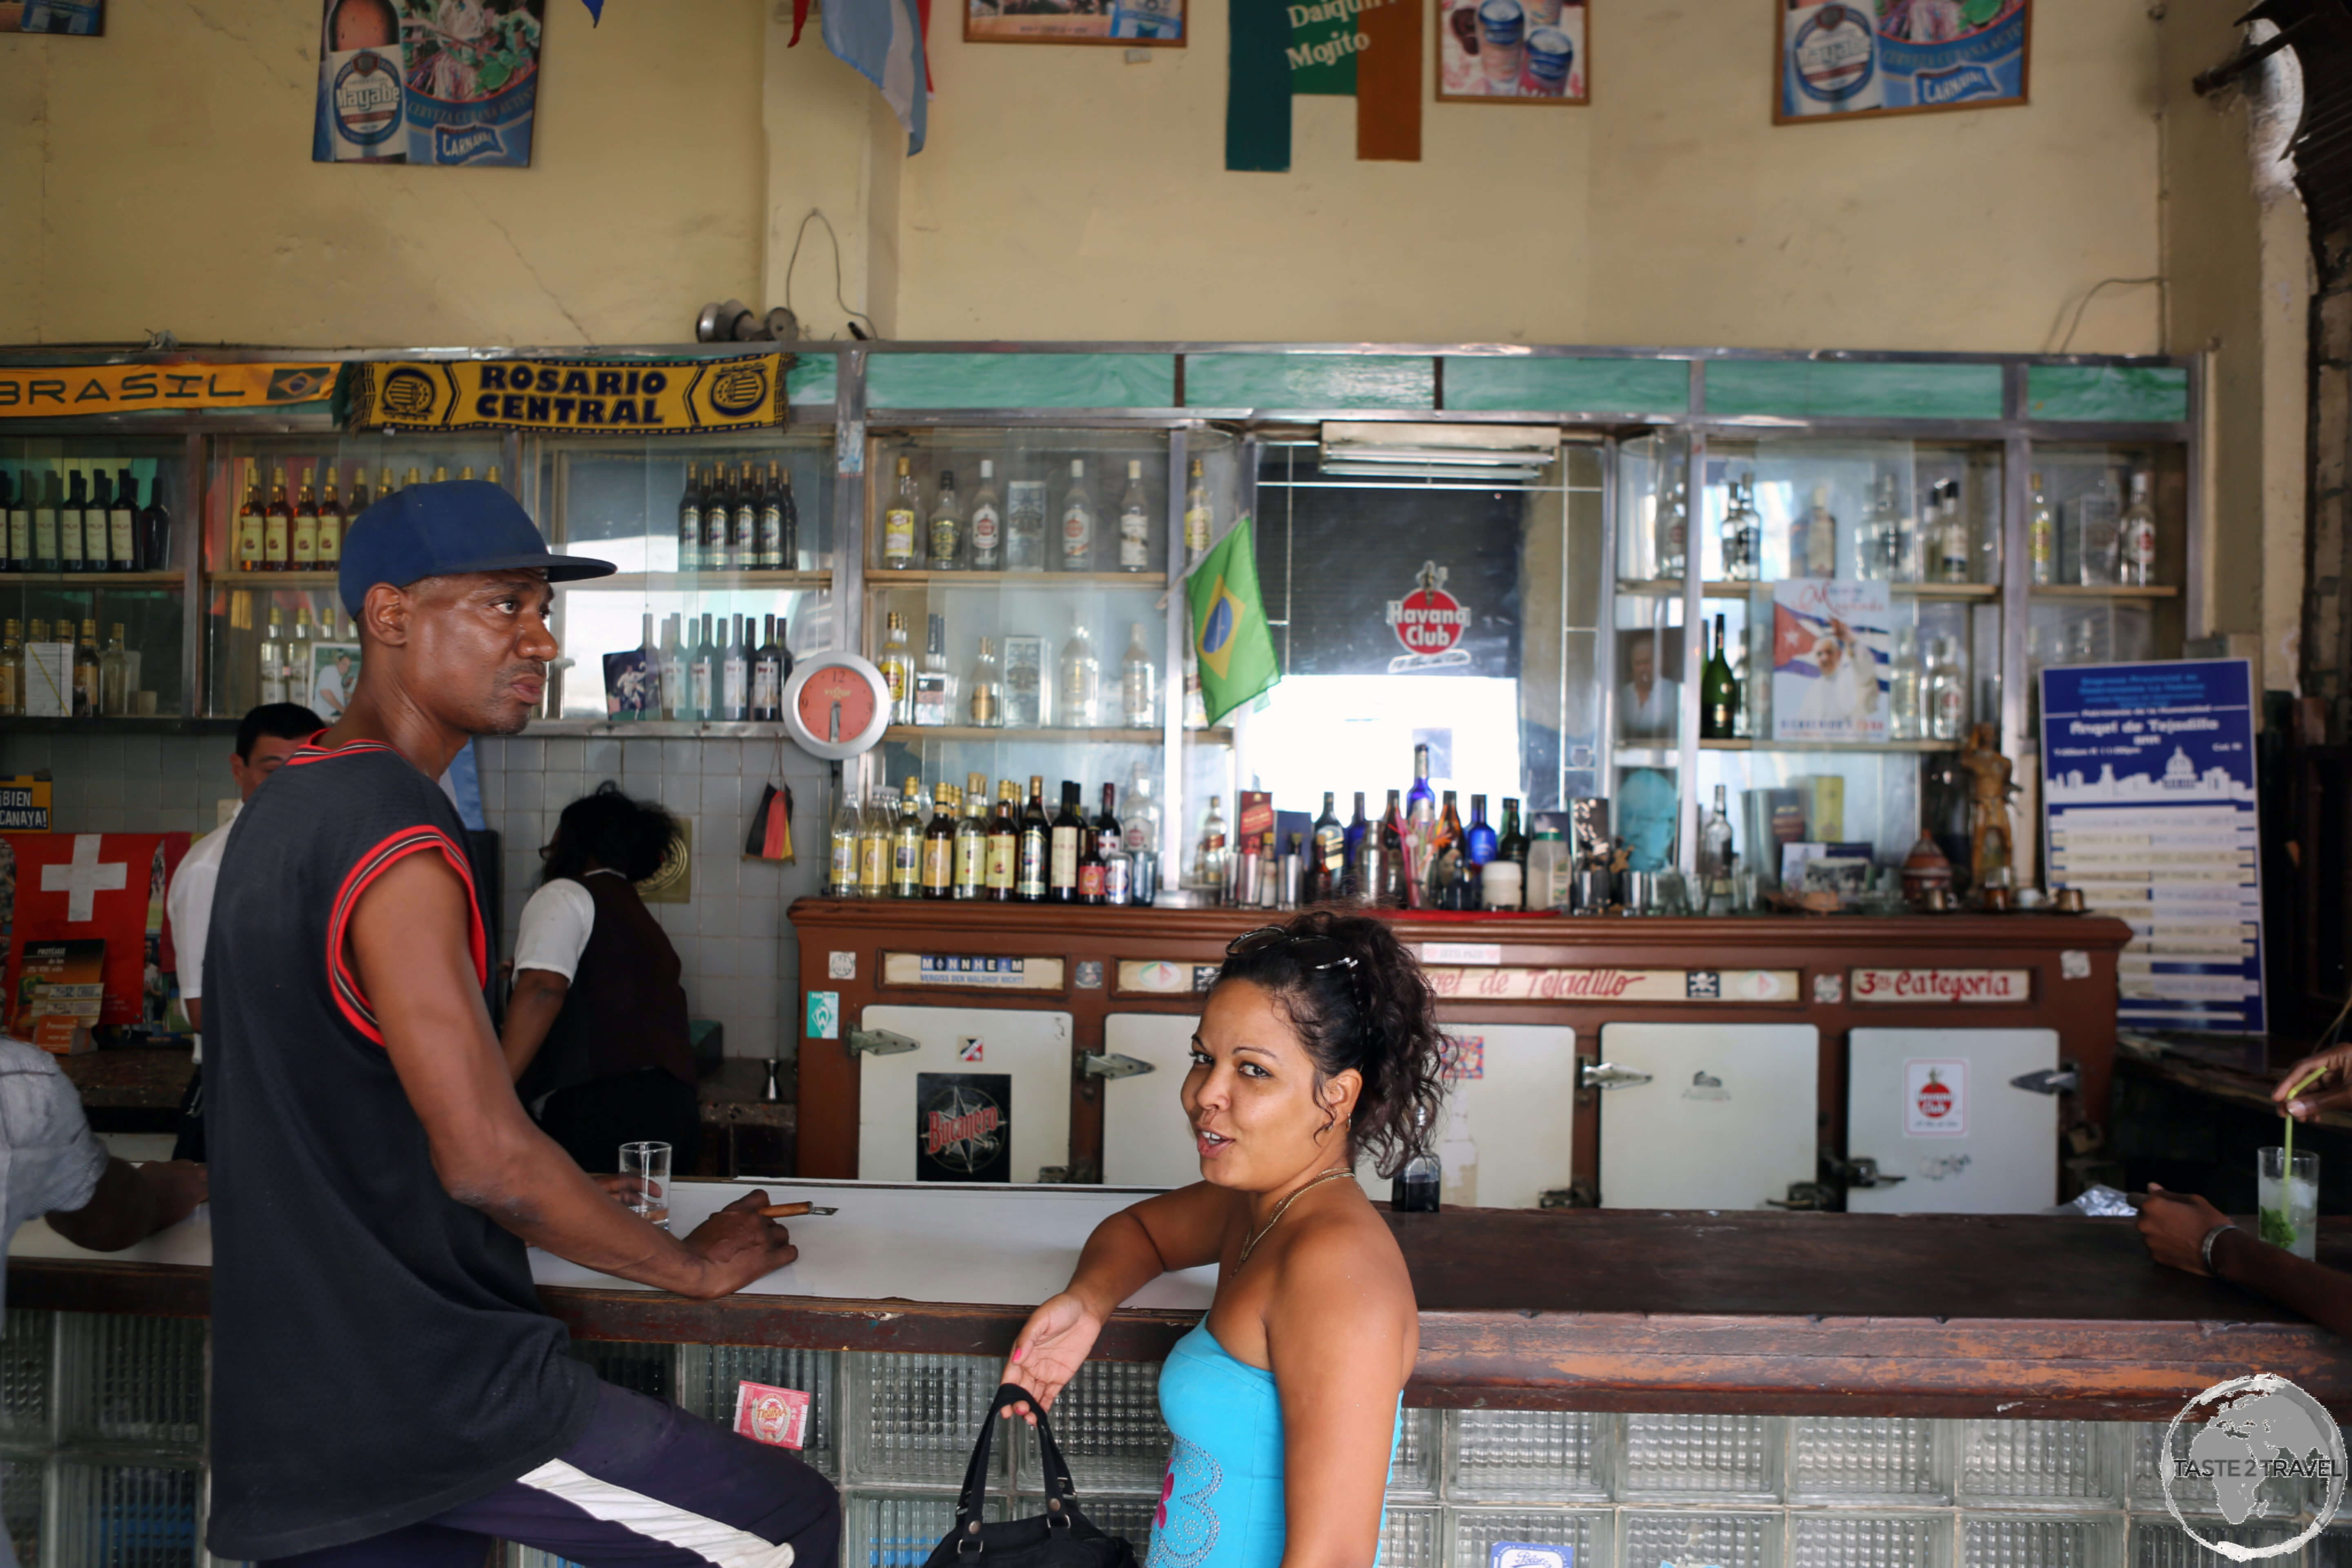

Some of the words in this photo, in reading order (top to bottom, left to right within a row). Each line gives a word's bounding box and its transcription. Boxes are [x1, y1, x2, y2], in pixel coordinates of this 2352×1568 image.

[1285, 31, 1371, 71] Mojito
[336, 86, 401, 111] Mayabe
[479, 364, 668, 396] ROSARIO
[475, 393, 665, 425] CENTRAL
[1390, 601, 1468, 624] Havana
[1405, 624, 1451, 646] Club
[833, 670, 846, 683] 12
[802, 698, 809, 709] 9
[2122, 720, 2143, 733] de
[2147, 717, 2219, 734] Tejadillo
[1479, 968, 1509, 994] de
[1526, 969, 1646, 999] Tejadillo
[1923, 1100, 1945, 1114] Club
